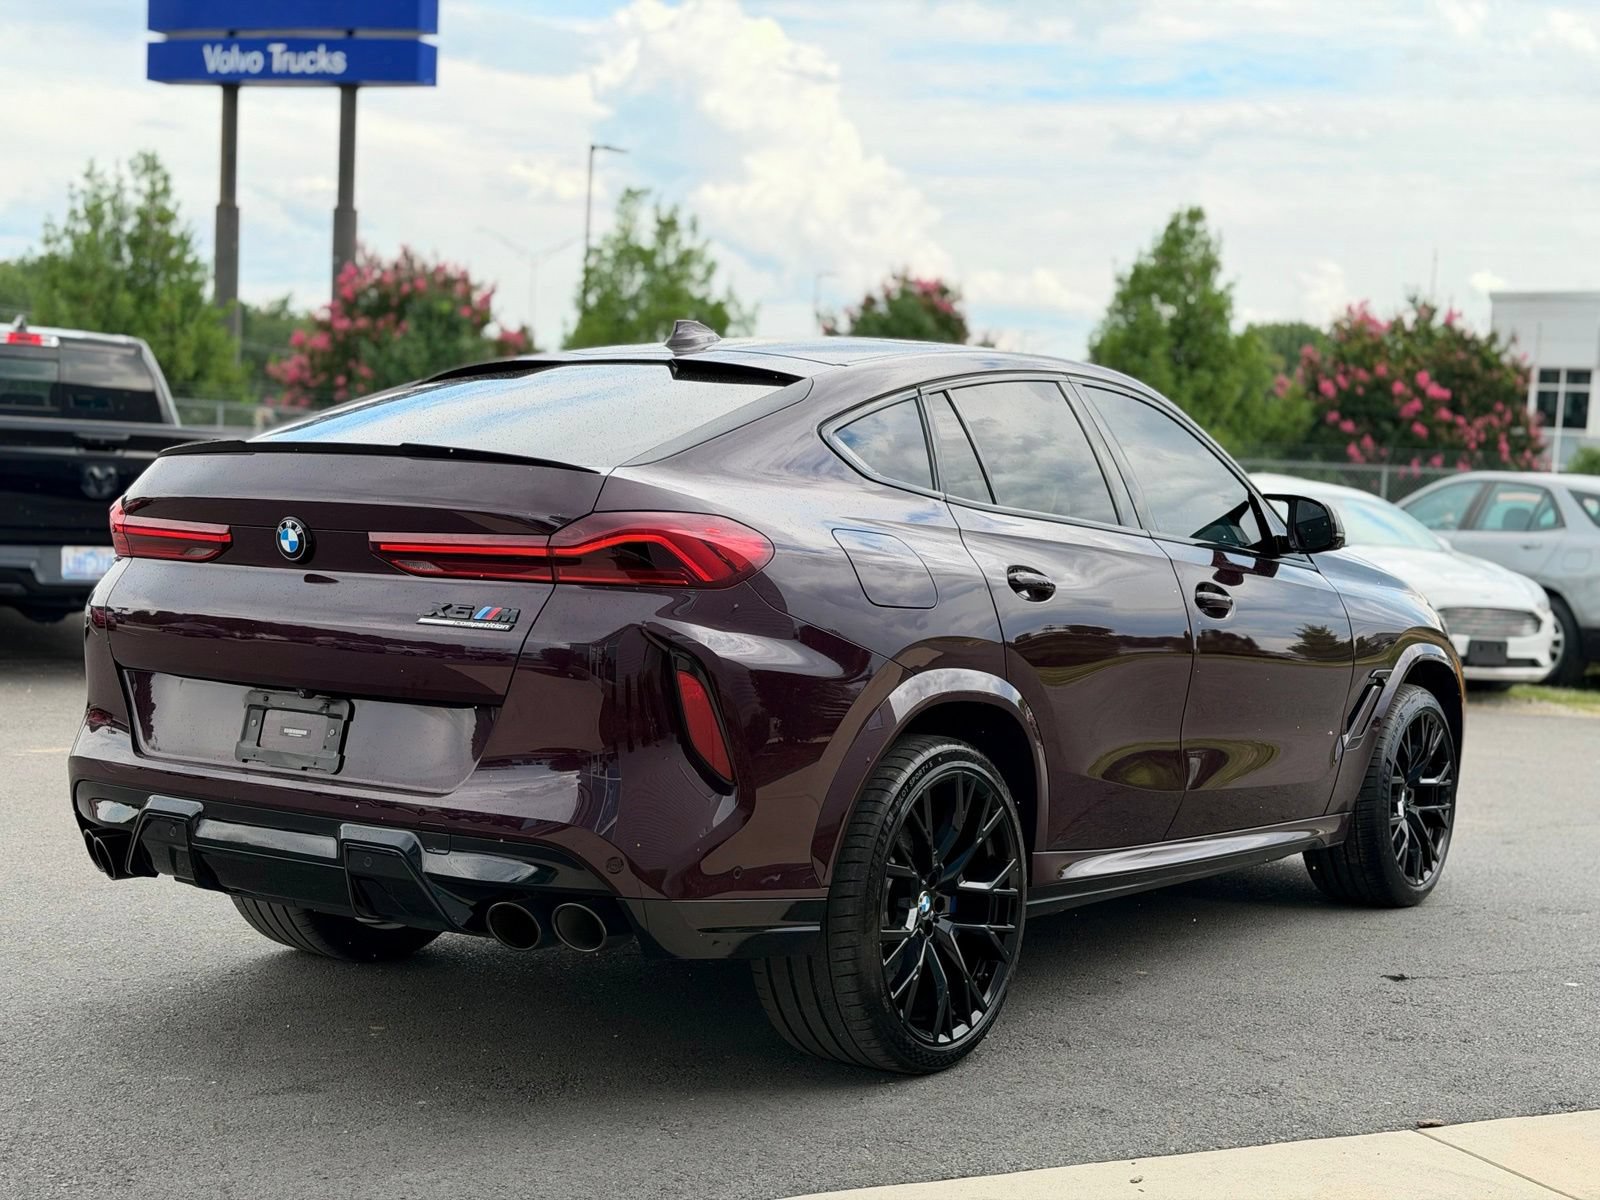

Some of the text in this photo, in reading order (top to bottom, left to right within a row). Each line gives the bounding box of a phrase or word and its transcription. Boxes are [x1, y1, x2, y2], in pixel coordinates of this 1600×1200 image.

[202, 43, 347, 74] Volvo Trucks
[278, 521, 302, 535] BMW
[423, 601, 475, 620] X6
[453, 619, 510, 630] competition
